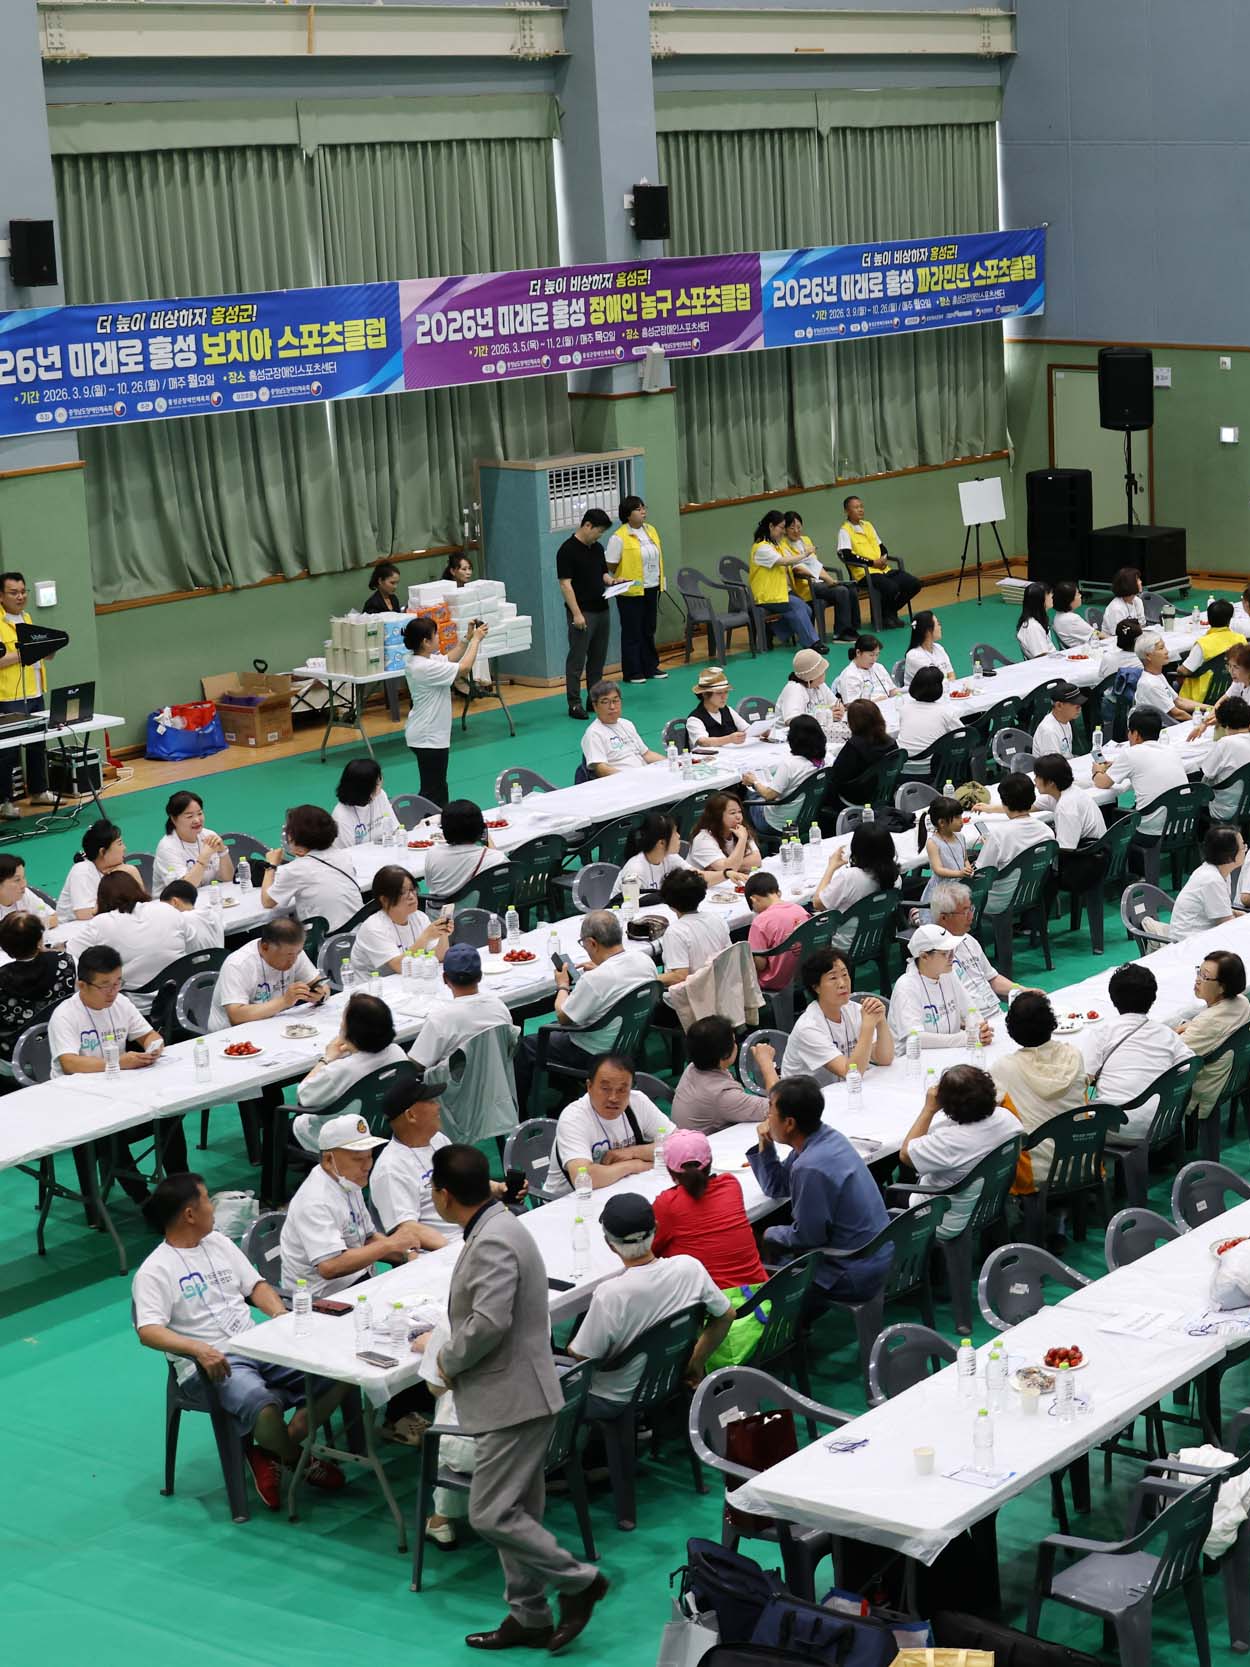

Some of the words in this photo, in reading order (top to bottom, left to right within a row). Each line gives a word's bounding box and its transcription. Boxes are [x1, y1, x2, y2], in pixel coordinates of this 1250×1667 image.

[862, 252, 871, 268] 더
[873, 250, 892, 267] 높이
[893, 247, 929, 265] 비상하자
[930, 244, 958, 262] 홍성군!
[529, 279, 540, 297] 더
[544, 277, 566, 296] 높이
[570, 272, 613, 292] 비상하자
[615, 269, 651, 289] 홍성군!
[772, 275, 838, 309] 2026년
[841, 271, 884, 302] 미래로
[886, 268, 915, 298] 홍성
[916, 262, 972, 294] 파라민턴
[972, 254, 1037, 288] 스포츠클럽
[96, 314, 112, 334] 더
[116, 312, 146, 333] 높이
[150, 307, 207, 330] 비상하자
[211, 303, 257, 325] 홍성군!
[415, 306, 494, 345] 2026년
[497, 301, 549, 336] 미래로
[552, 297, 587, 330] 홍성
[589, 292, 638, 326] 장애인
[640, 288, 673, 320] 농구
[675, 282, 751, 317] 스포츠클럽
[68, 338, 145, 379] 미래로
[148, 333, 198, 372] 홍성
[202, 327, 273, 367] 보치아
[277, 316, 388, 360] 스포츠클럽
[473, 344, 489, 358] 기간
[228, 370, 247, 385] 장소
[248, 361, 338, 382] 홍성군장애인스포츠센터
[21, 390, 41, 406] 기간
[43, 387, 72, 403] 2026.
[72, 386, 82, 400] 3.
[83, 382, 107, 399] 9.(월)
[117, 381, 130, 396] 10.
[132, 378, 161, 394] 26.(월)
[168, 376, 187, 391] 매주
[187, 372, 216, 389] 월요일
